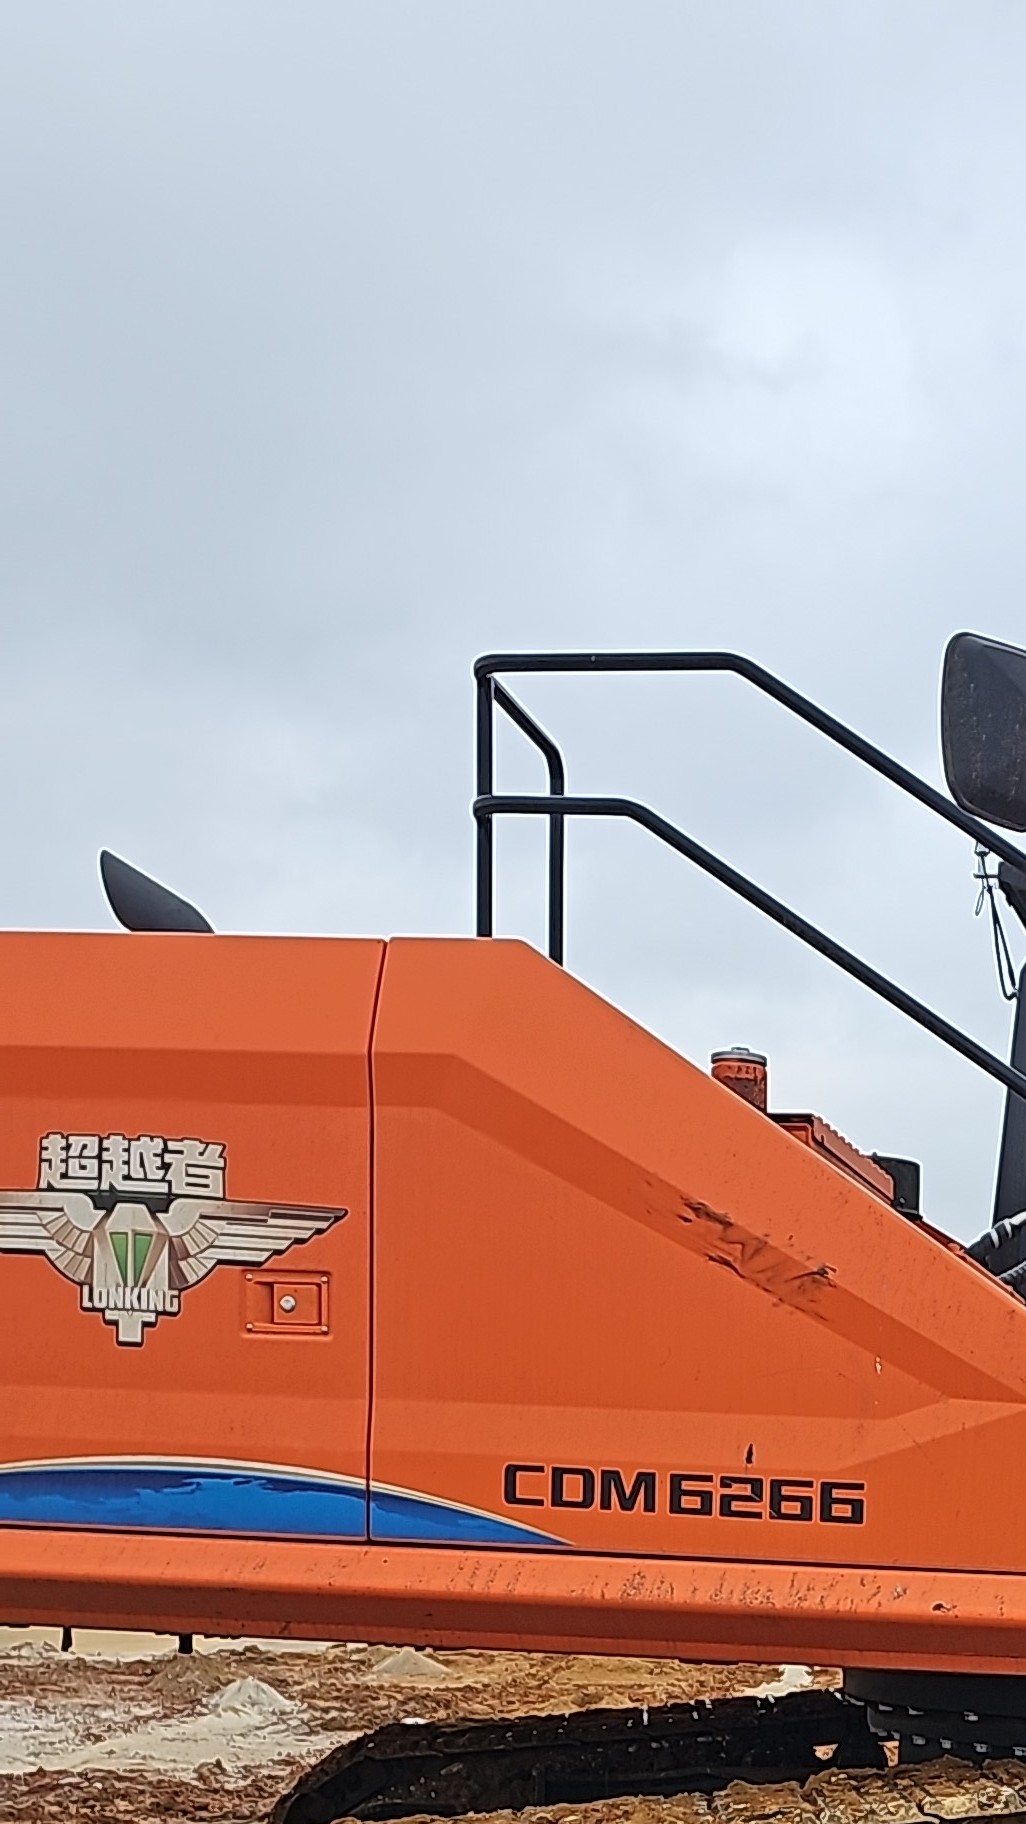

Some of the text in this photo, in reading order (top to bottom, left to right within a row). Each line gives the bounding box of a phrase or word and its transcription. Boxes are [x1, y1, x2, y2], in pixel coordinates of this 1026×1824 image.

[41, 1134, 225, 1198] 超越者
[82, 1284, 180, 1313] LONKING
